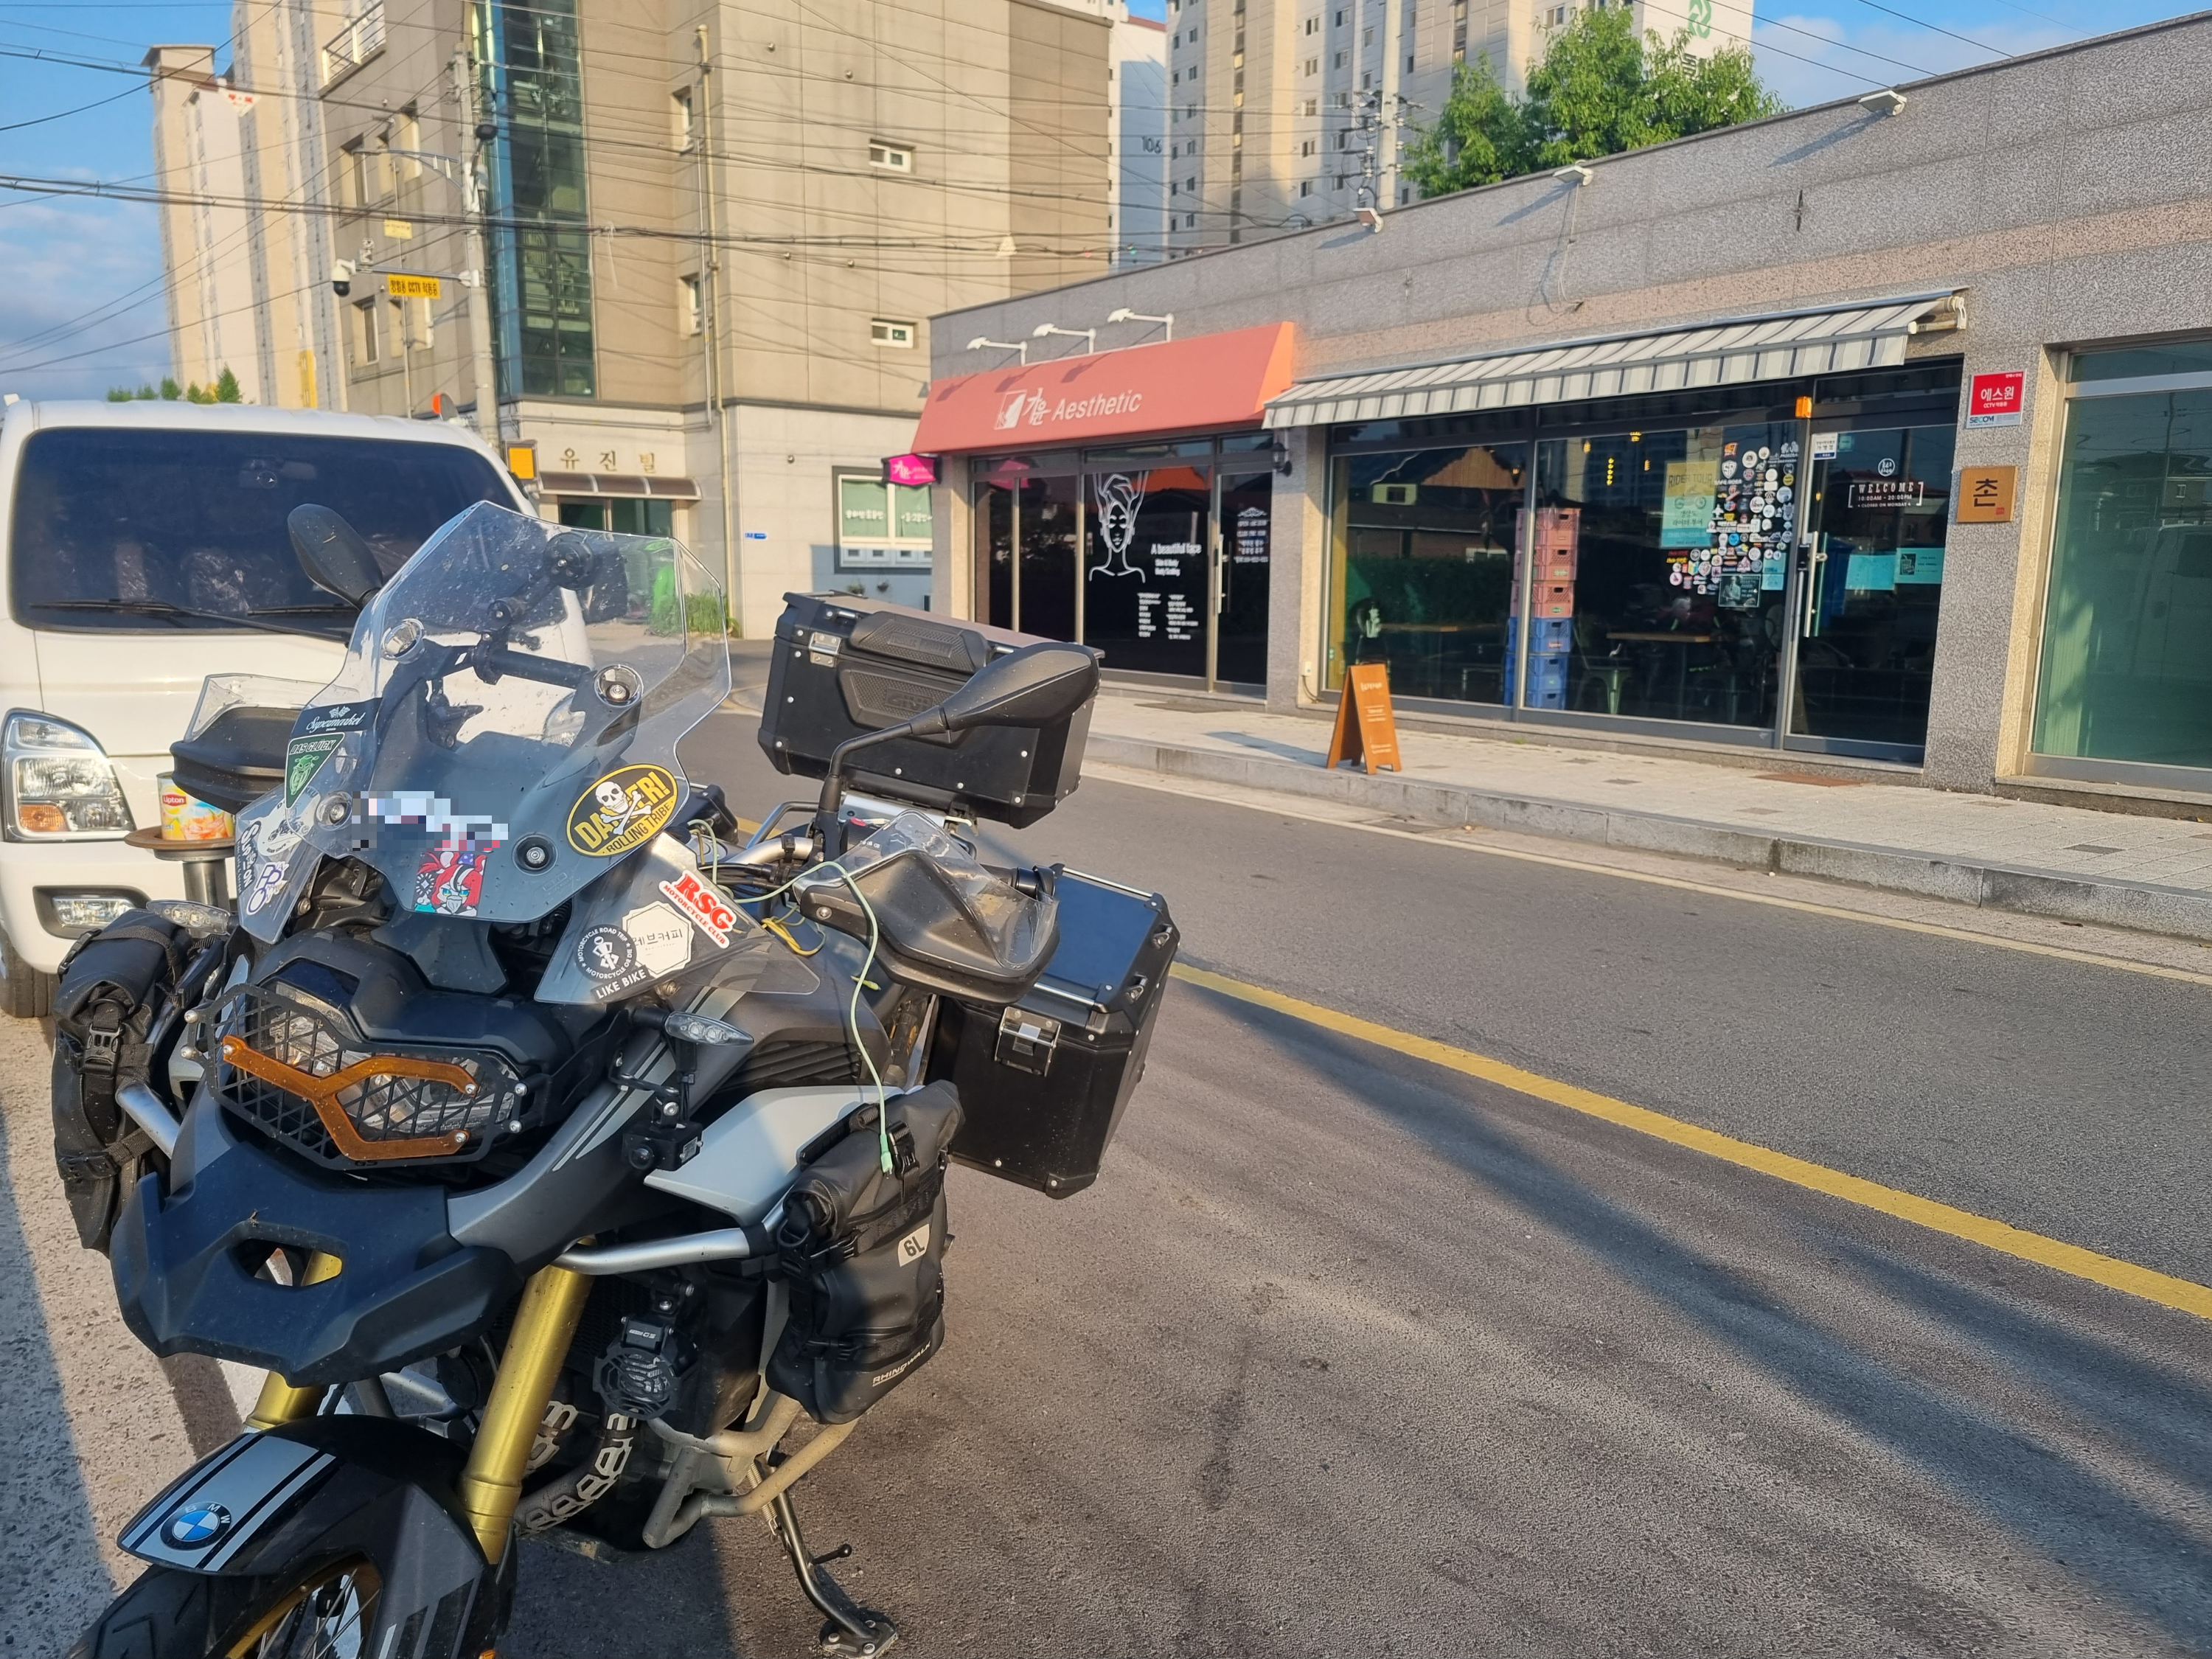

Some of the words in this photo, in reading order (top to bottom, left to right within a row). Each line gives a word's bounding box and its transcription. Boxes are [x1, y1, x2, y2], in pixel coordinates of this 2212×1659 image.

[1141, 136, 1162, 154] 106
[407, 282, 421, 293] CCTV
[1980, 386, 2014, 402] 에스원
[1051, 389, 1143, 422] Aesthetic
[1969, 416, 1994, 424] SECOM
[560, 448, 656, 474] 유진빌
[1669, 474, 1691, 488] RIDER
[1693, 473, 1713, 487] TOUR
[1858, 481, 1913, 494] WELCOME
[1972, 478, 1998, 507] 촌
[1151, 543, 1157, 554] A
[1157, 543, 1186, 554] beautiful
[1186, 543, 1202, 556] face
[305, 712, 366, 734] Supermarket
[288, 742, 307, 756] DAS
[307, 738, 337, 754] GLÜCK
[163, 795, 185, 804] Lipton
[574, 771, 672, 849] DAER!
[605, 822, 650, 853] ROLLING
[647, 801, 672, 828] TRIBE
[674, 873, 734, 930] RSG
[663, 884, 709, 928] MOTORCYCLE
[708, 926, 726, 945] CLUB
[577, 928, 599, 963] MOTORCYCLE
[599, 926, 617, 935] ROAD
[616, 931, 629, 942] TRIP
[585, 965, 627, 980] MOTORCYCLE
[624, 958, 632, 967] OR
[595, 981, 621, 1000] LIKE
[621, 968, 647, 988] BIKE
[902, 1235, 926, 1257] 6L
[872, 1340, 932, 1385] RHINOWALK
[184, 1503, 231, 1524] BMW
